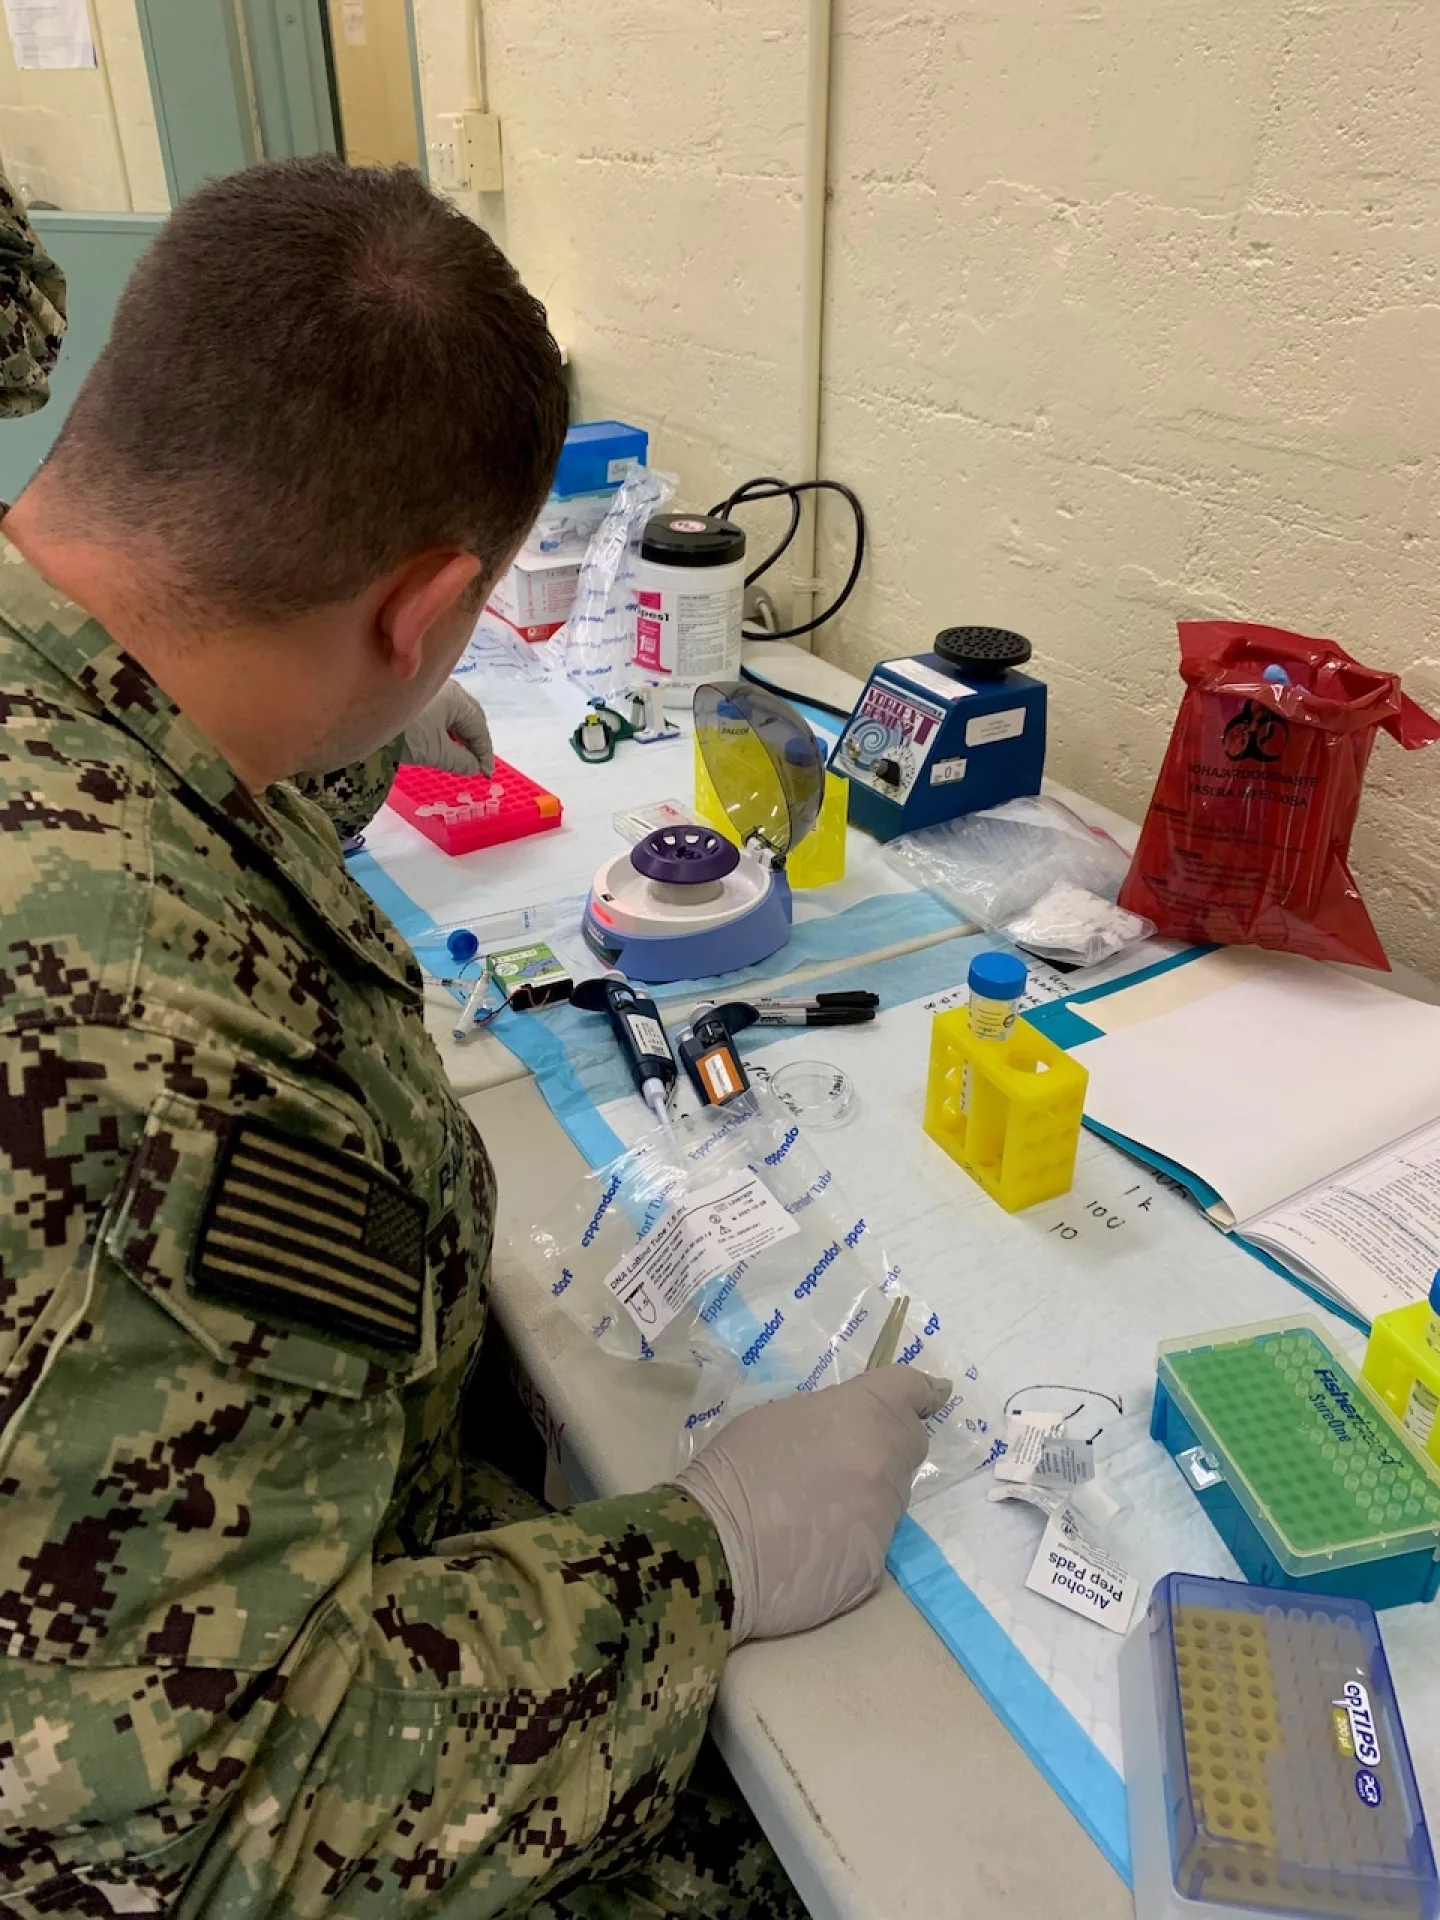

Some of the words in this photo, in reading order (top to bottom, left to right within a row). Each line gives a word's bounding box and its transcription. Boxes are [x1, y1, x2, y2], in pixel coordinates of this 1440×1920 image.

[581, 1175, 622, 1248] eppendorf
[1047, 1221, 1079, 1241] 10
[609, 1271, 628, 1290] DNA
[651, 1227, 668, 1250] Tube
[698, 1258, 749, 1325] Eppendorf
[741, 1307, 786, 1367] eppendorf
[1309, 1393, 1352, 1443] SureOne
[1048, 1551, 1087, 1581] Pads
[1089, 1572, 1123, 1603] Prep
[1051, 1571, 1111, 1610] Alcohol
[1363, 1774, 1379, 1804] PCR
